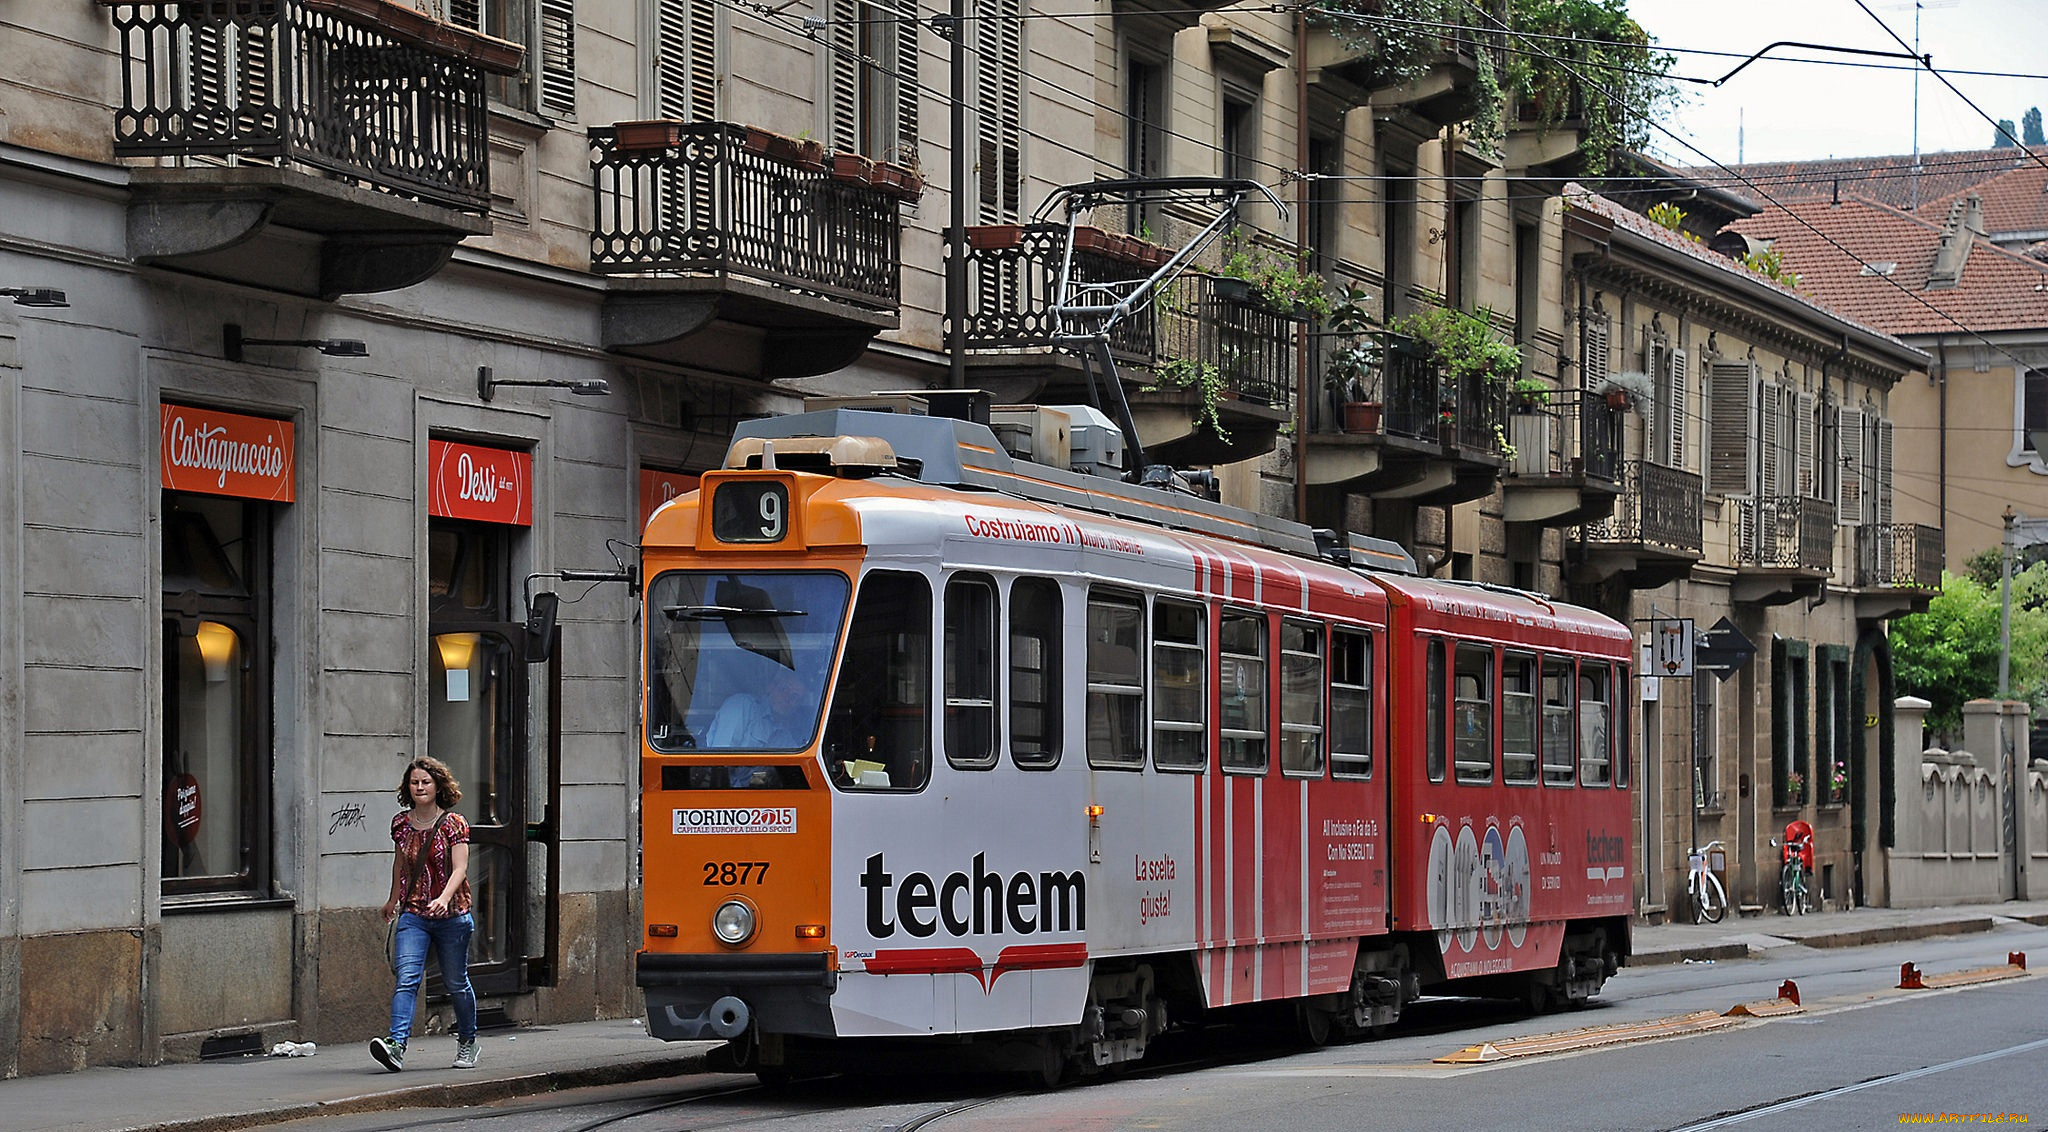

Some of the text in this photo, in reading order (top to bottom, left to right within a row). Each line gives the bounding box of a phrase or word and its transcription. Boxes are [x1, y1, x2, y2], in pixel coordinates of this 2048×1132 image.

[171, 416, 283, 488] Castagnaccio
[458, 452, 498, 503] Dessì
[759, 491, 782, 538] 9
[965, 514, 1061, 544] Costruiamo
[1061, 523, 1075, 545] il
[676, 826, 710, 834] CAPITALE
[745, 825, 768, 833] DELLO
[1586, 828, 1623, 864] techem
[703, 862, 770, 886] 2877
[1135, 853, 1175, 881] La scelta
[860, 851, 1087, 939] techem
[1140, 889, 1171, 926] giusta!
